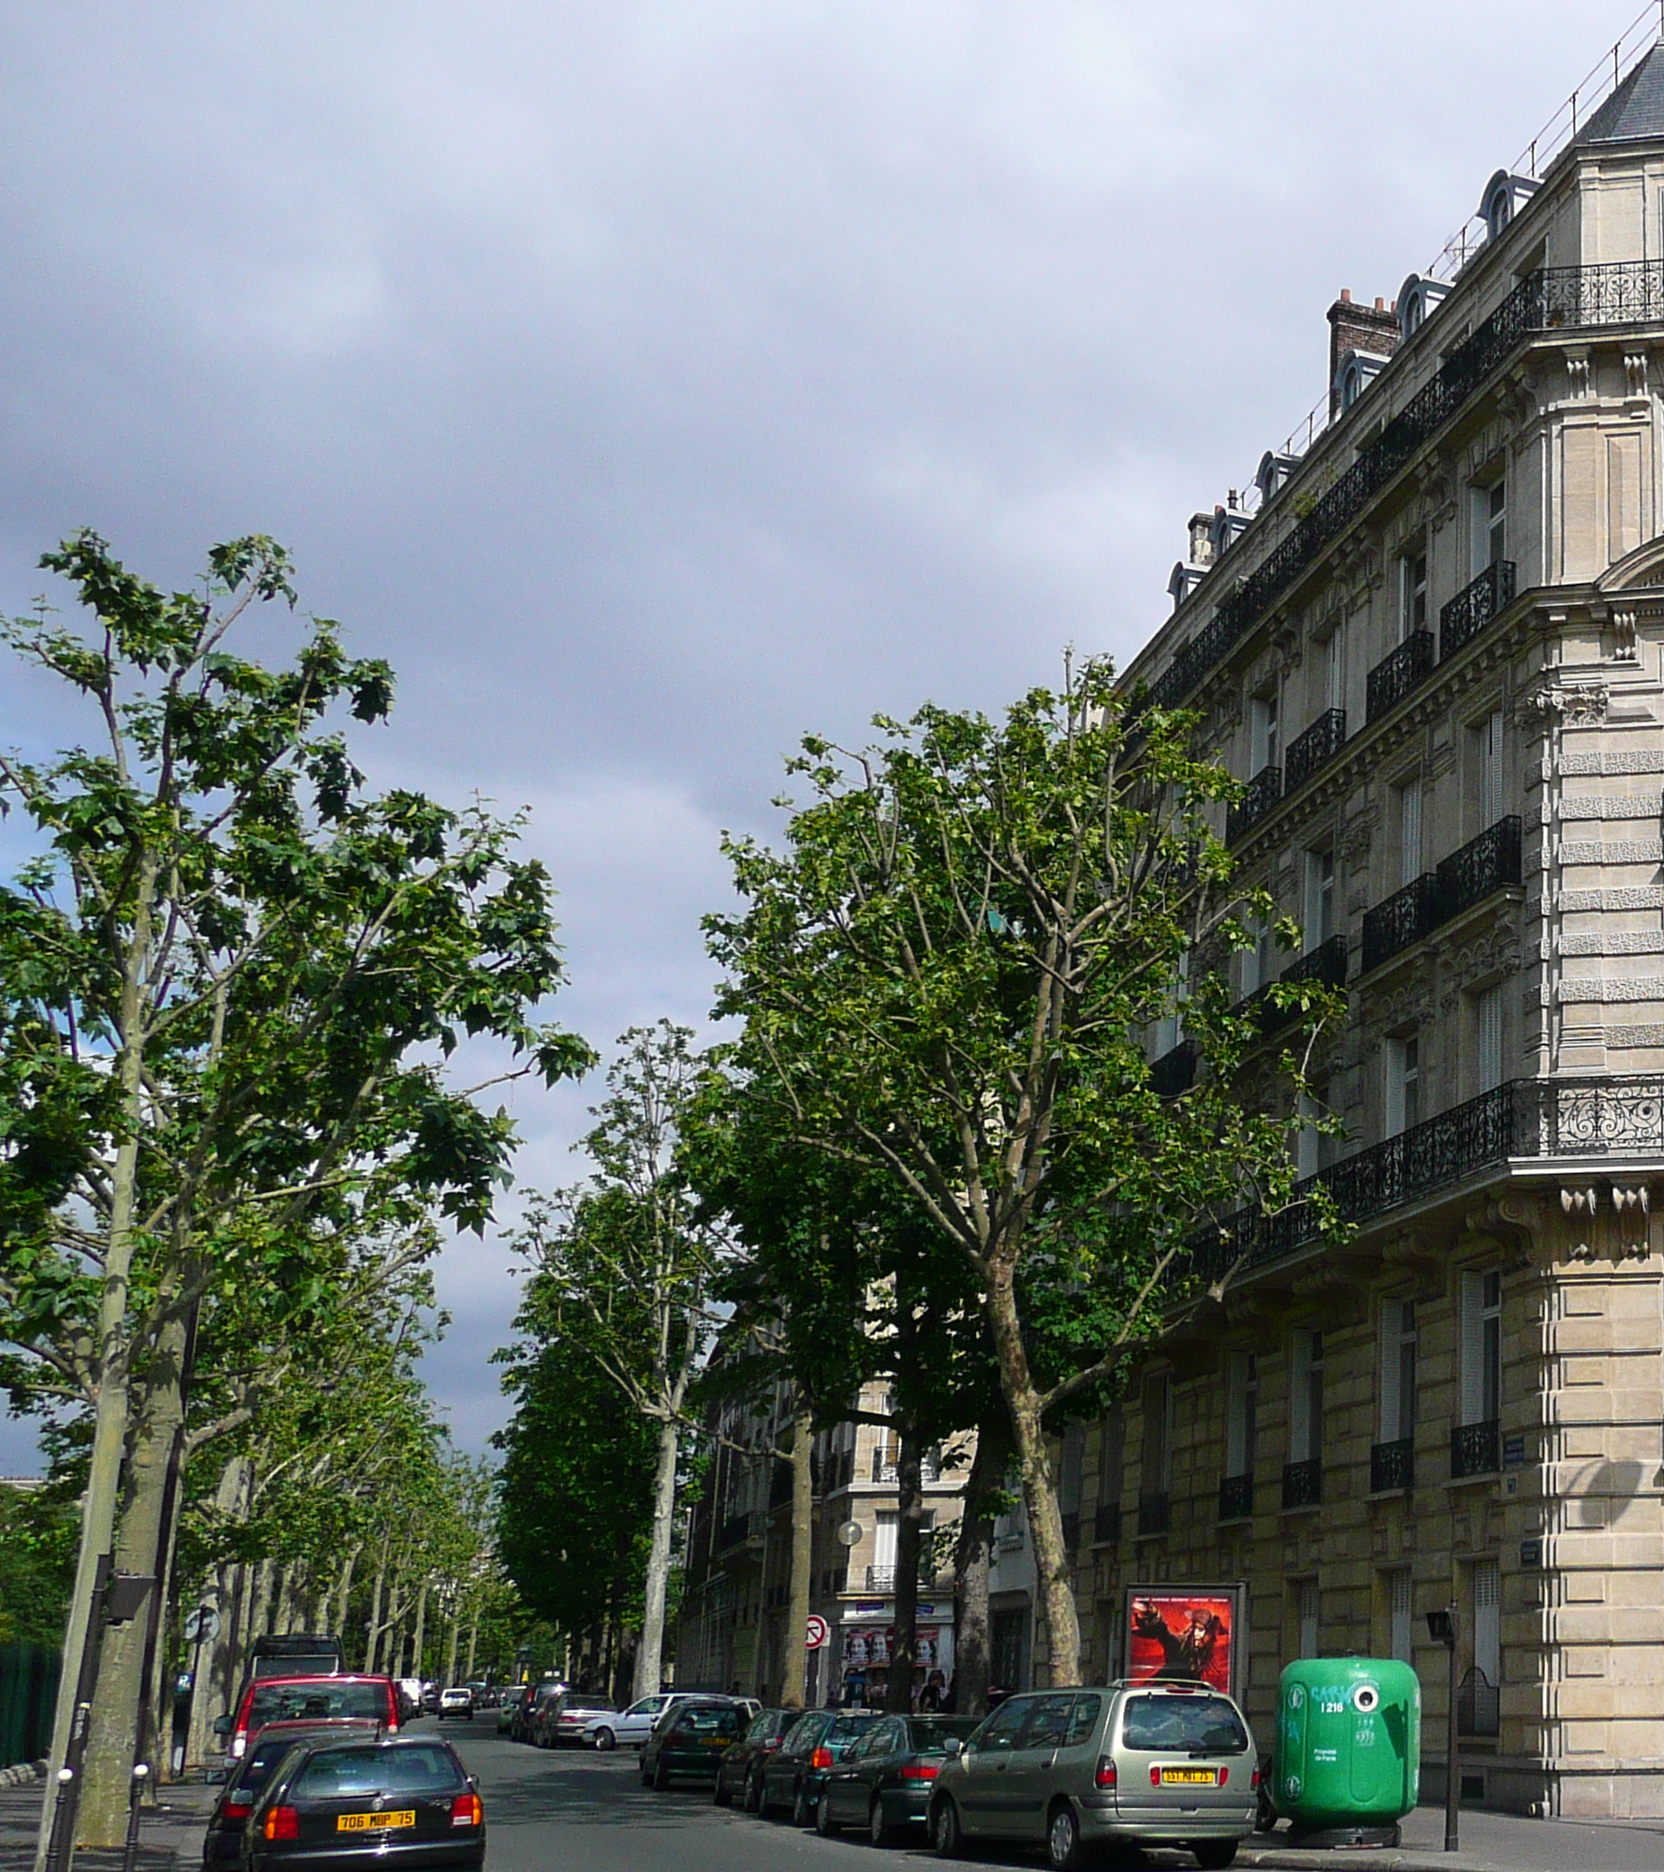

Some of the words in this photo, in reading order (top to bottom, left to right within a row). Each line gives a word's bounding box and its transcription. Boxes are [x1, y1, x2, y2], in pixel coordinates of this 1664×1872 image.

[1326, 1702, 1344, 1713] 216
[341, 1815, 364, 1829] 706
[398, 1812, 413, 1825] 75
